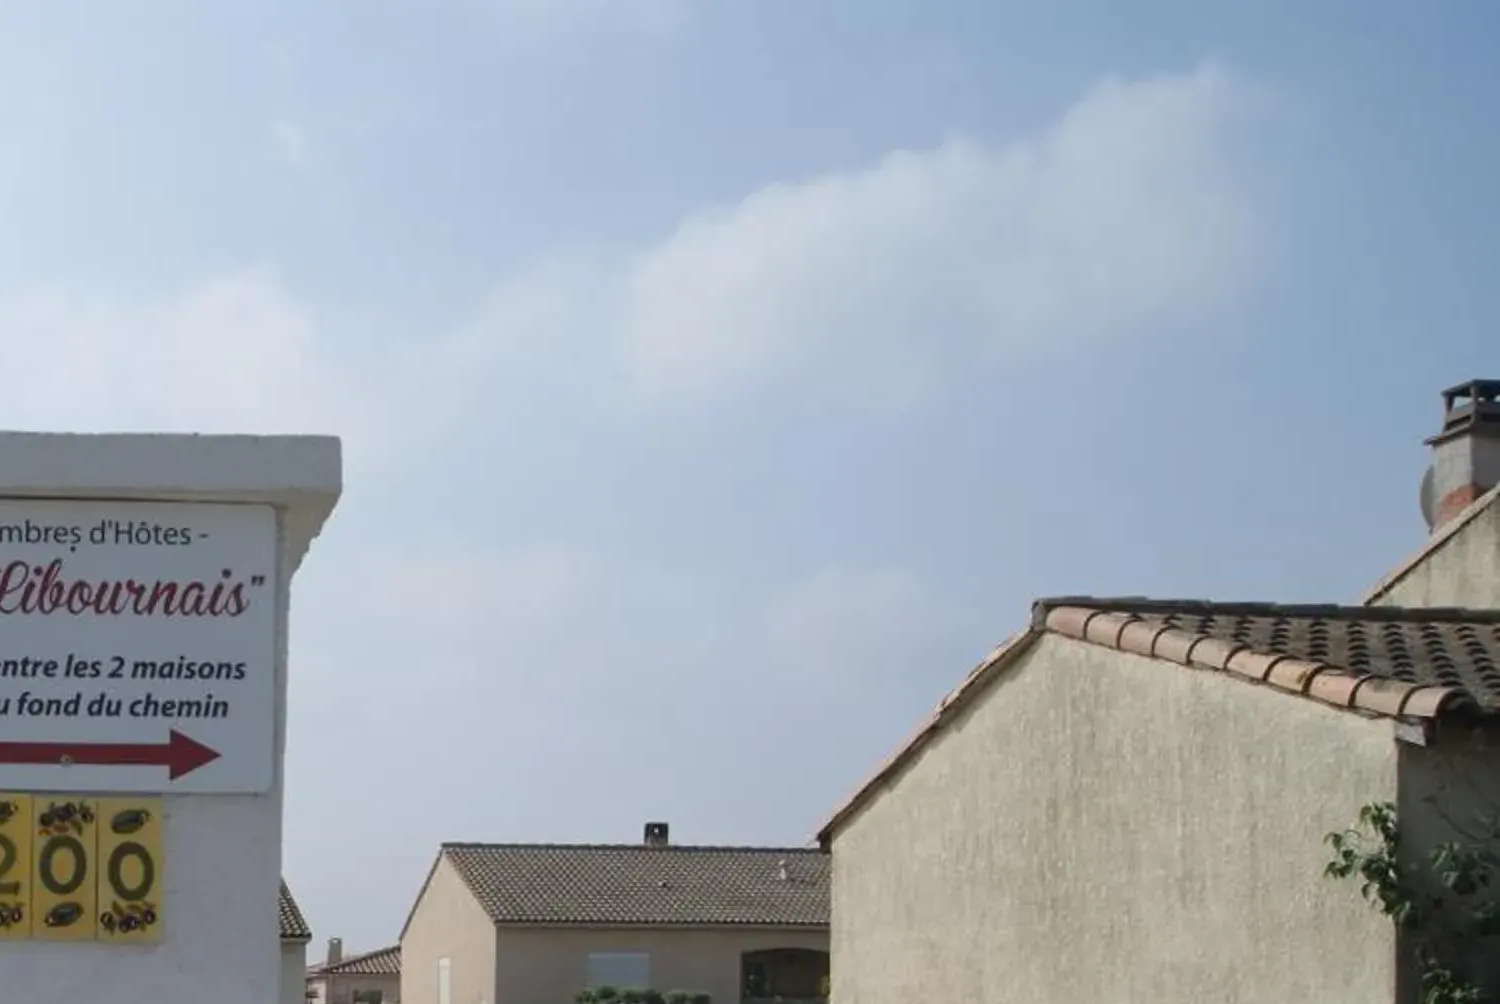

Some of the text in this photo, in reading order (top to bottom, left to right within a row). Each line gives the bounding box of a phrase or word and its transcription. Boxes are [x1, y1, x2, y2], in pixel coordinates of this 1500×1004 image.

[89, 519, 192, 546] d'Hôtes
[64, 655, 100, 678] les
[107, 656, 125, 678] 2
[132, 656, 247, 680] maisons
[15, 692, 80, 718] fond
[87, 692, 121, 717] du
[129, 693, 229, 719] chemin
